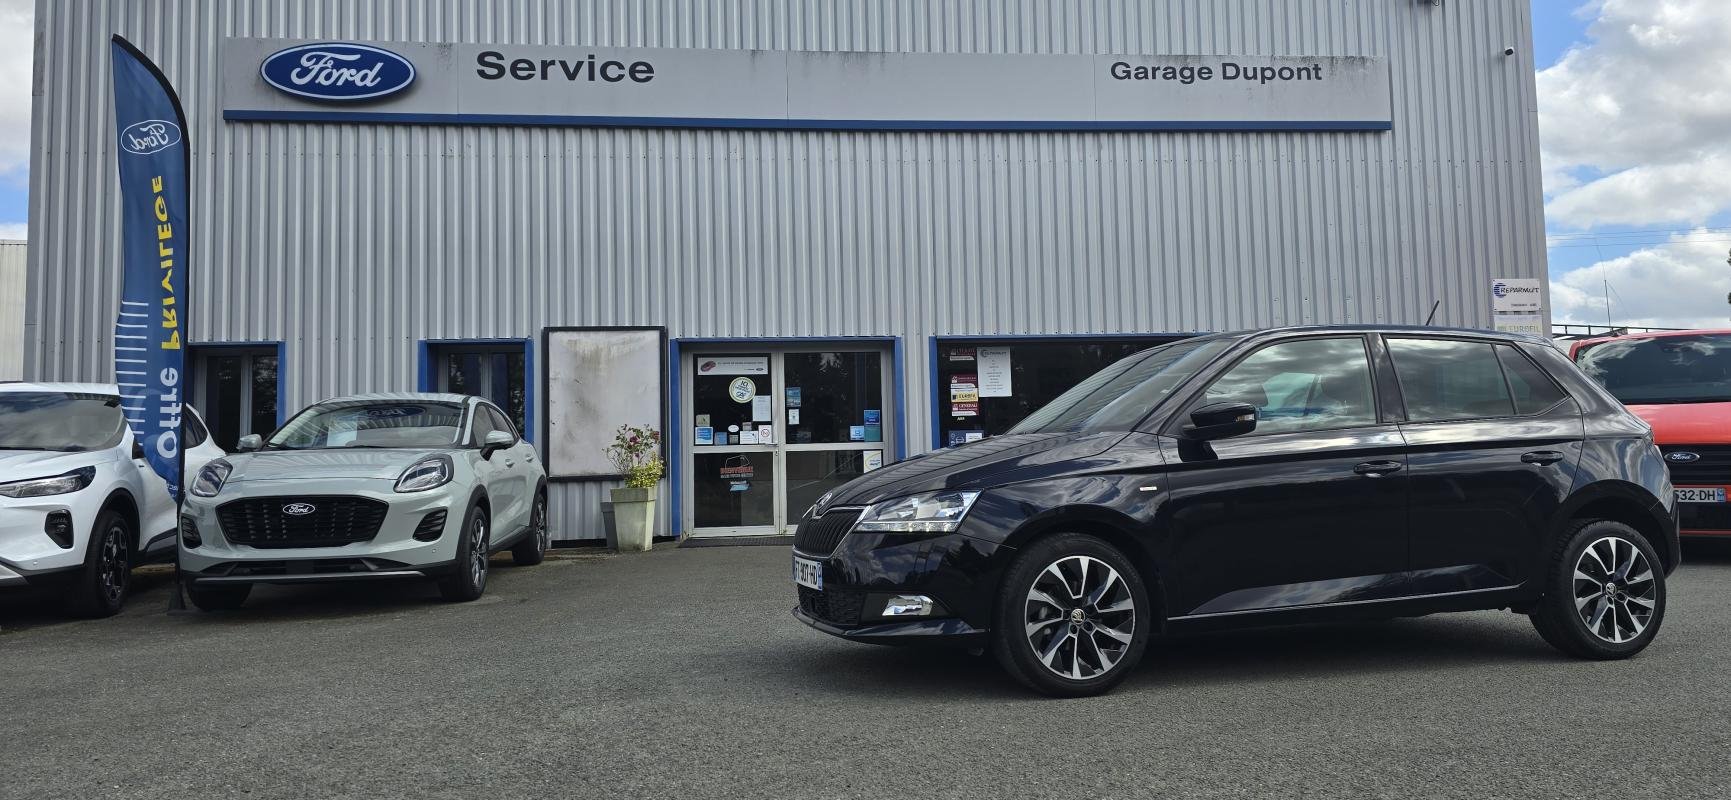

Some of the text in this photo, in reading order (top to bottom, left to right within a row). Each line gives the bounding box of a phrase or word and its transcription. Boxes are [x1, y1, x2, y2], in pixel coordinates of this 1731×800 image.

[290, 51, 383, 88] Ford
[476, 50, 656, 84] Service
[1110, 61, 1323, 85] Garage Dupont
[288, 503, 310, 513] Ford
